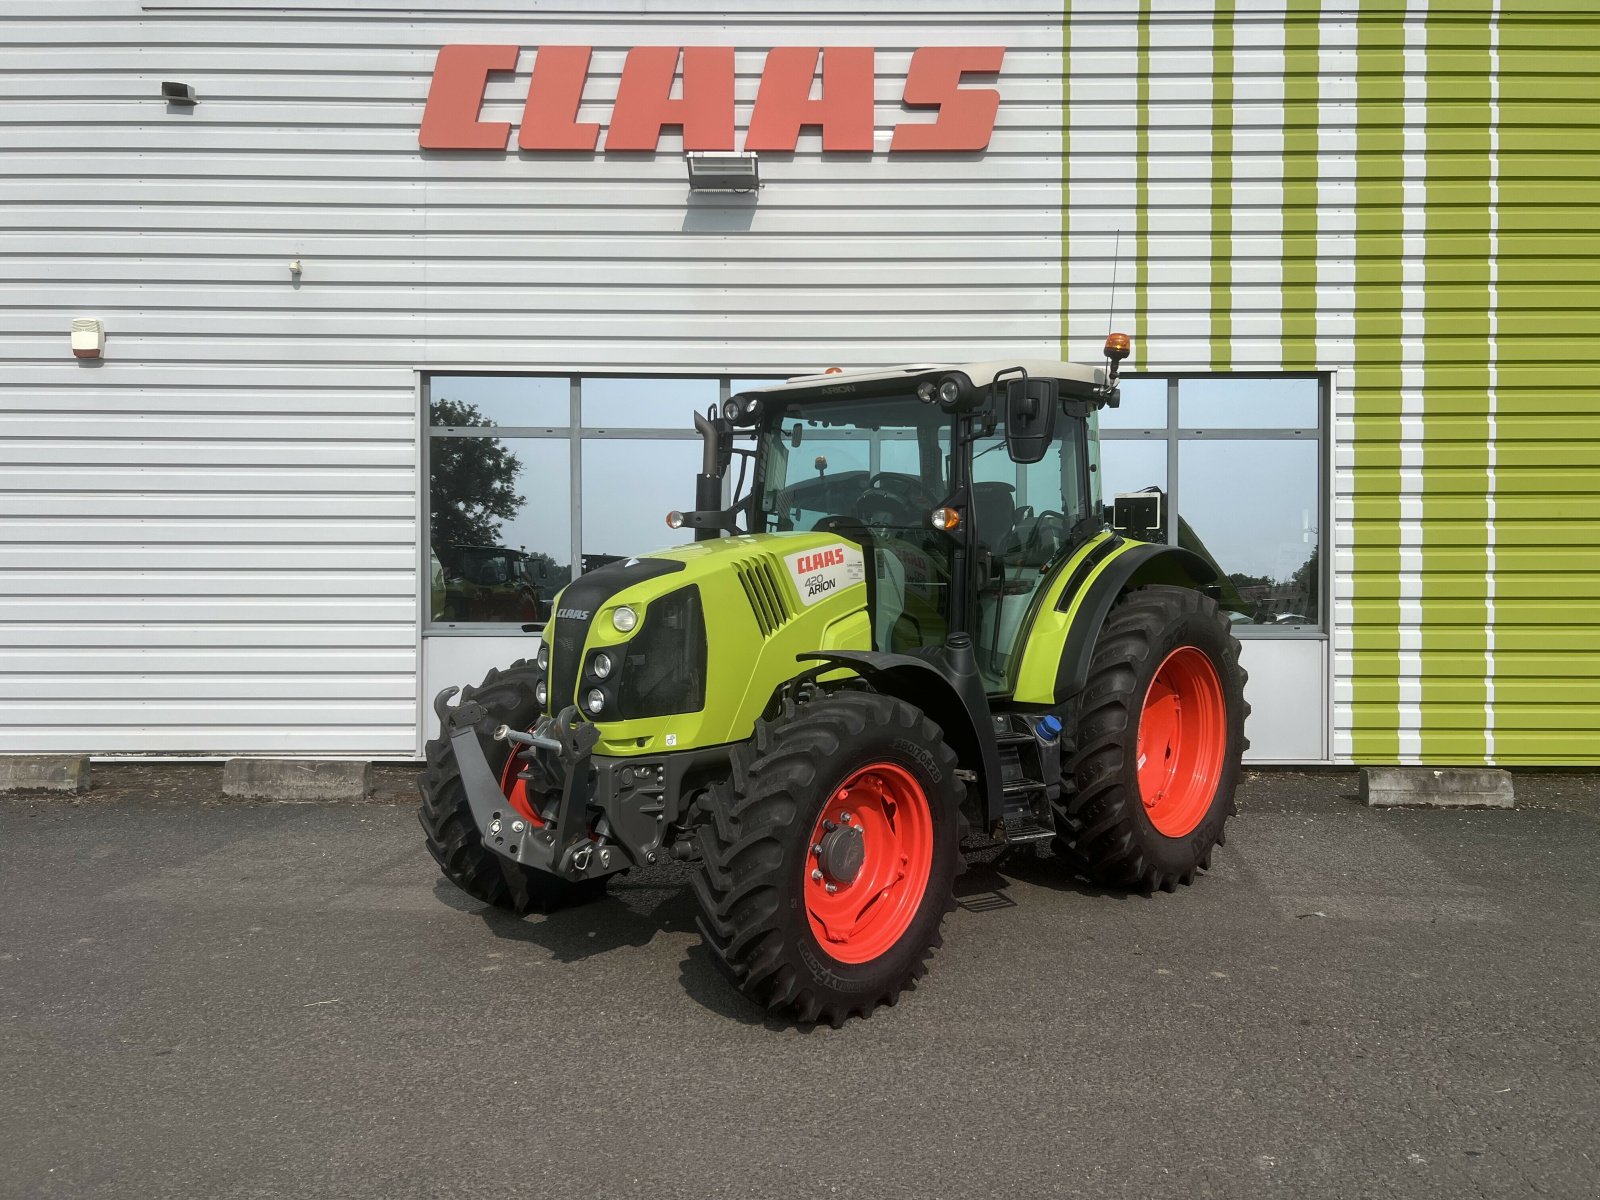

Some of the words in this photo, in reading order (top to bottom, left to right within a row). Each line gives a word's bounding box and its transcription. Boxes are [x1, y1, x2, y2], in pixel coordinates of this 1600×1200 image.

[418, 44, 1005, 152] CLAAS
[797, 548, 845, 575] CLAAS
[804, 574, 824, 588] 420
[808, 578, 836, 597] ARION
[556, 608, 590, 620] CLAAS
